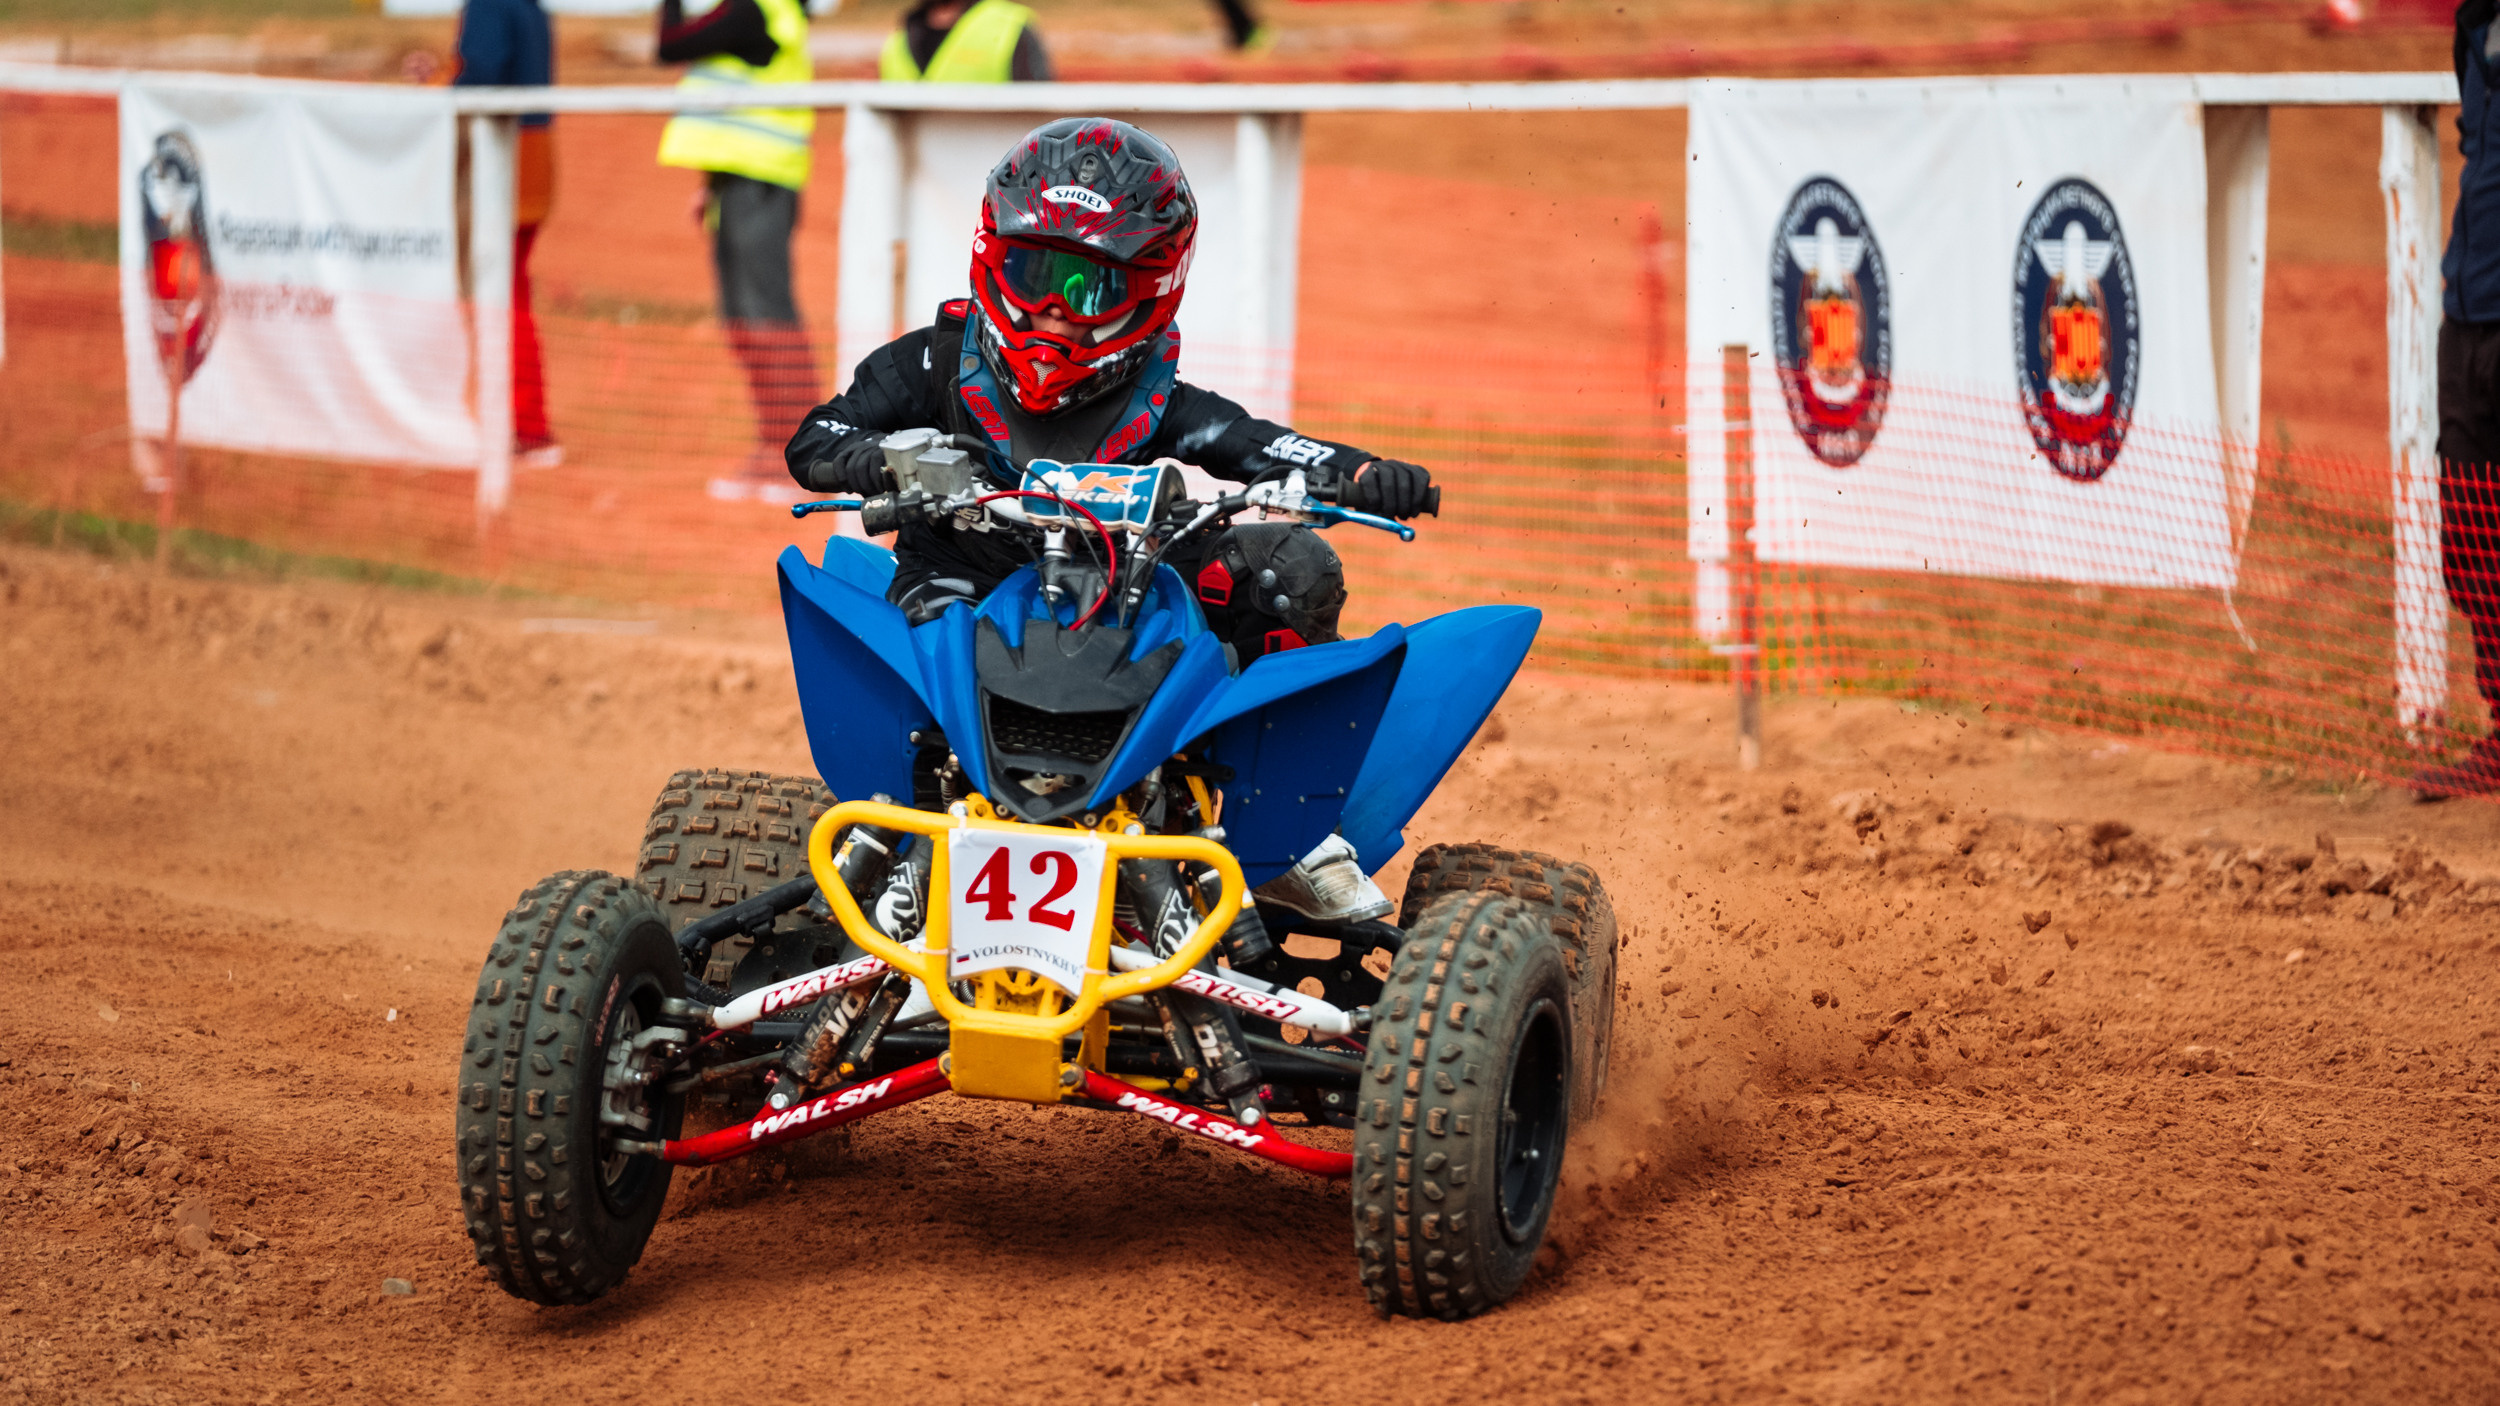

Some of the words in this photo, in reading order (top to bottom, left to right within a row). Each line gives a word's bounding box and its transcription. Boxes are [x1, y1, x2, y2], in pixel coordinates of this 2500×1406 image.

[1054, 188, 1102, 209] SHOEI
[813, 504, 843, 512] ASV
[864, 498, 889, 510] ASV
[965, 846, 1078, 932] 42
[972, 944, 1069, 973] VOLOSTNYKH
[750, 1077, 894, 1140] WALSH
[1117, 1091, 1265, 1148] WALSH
